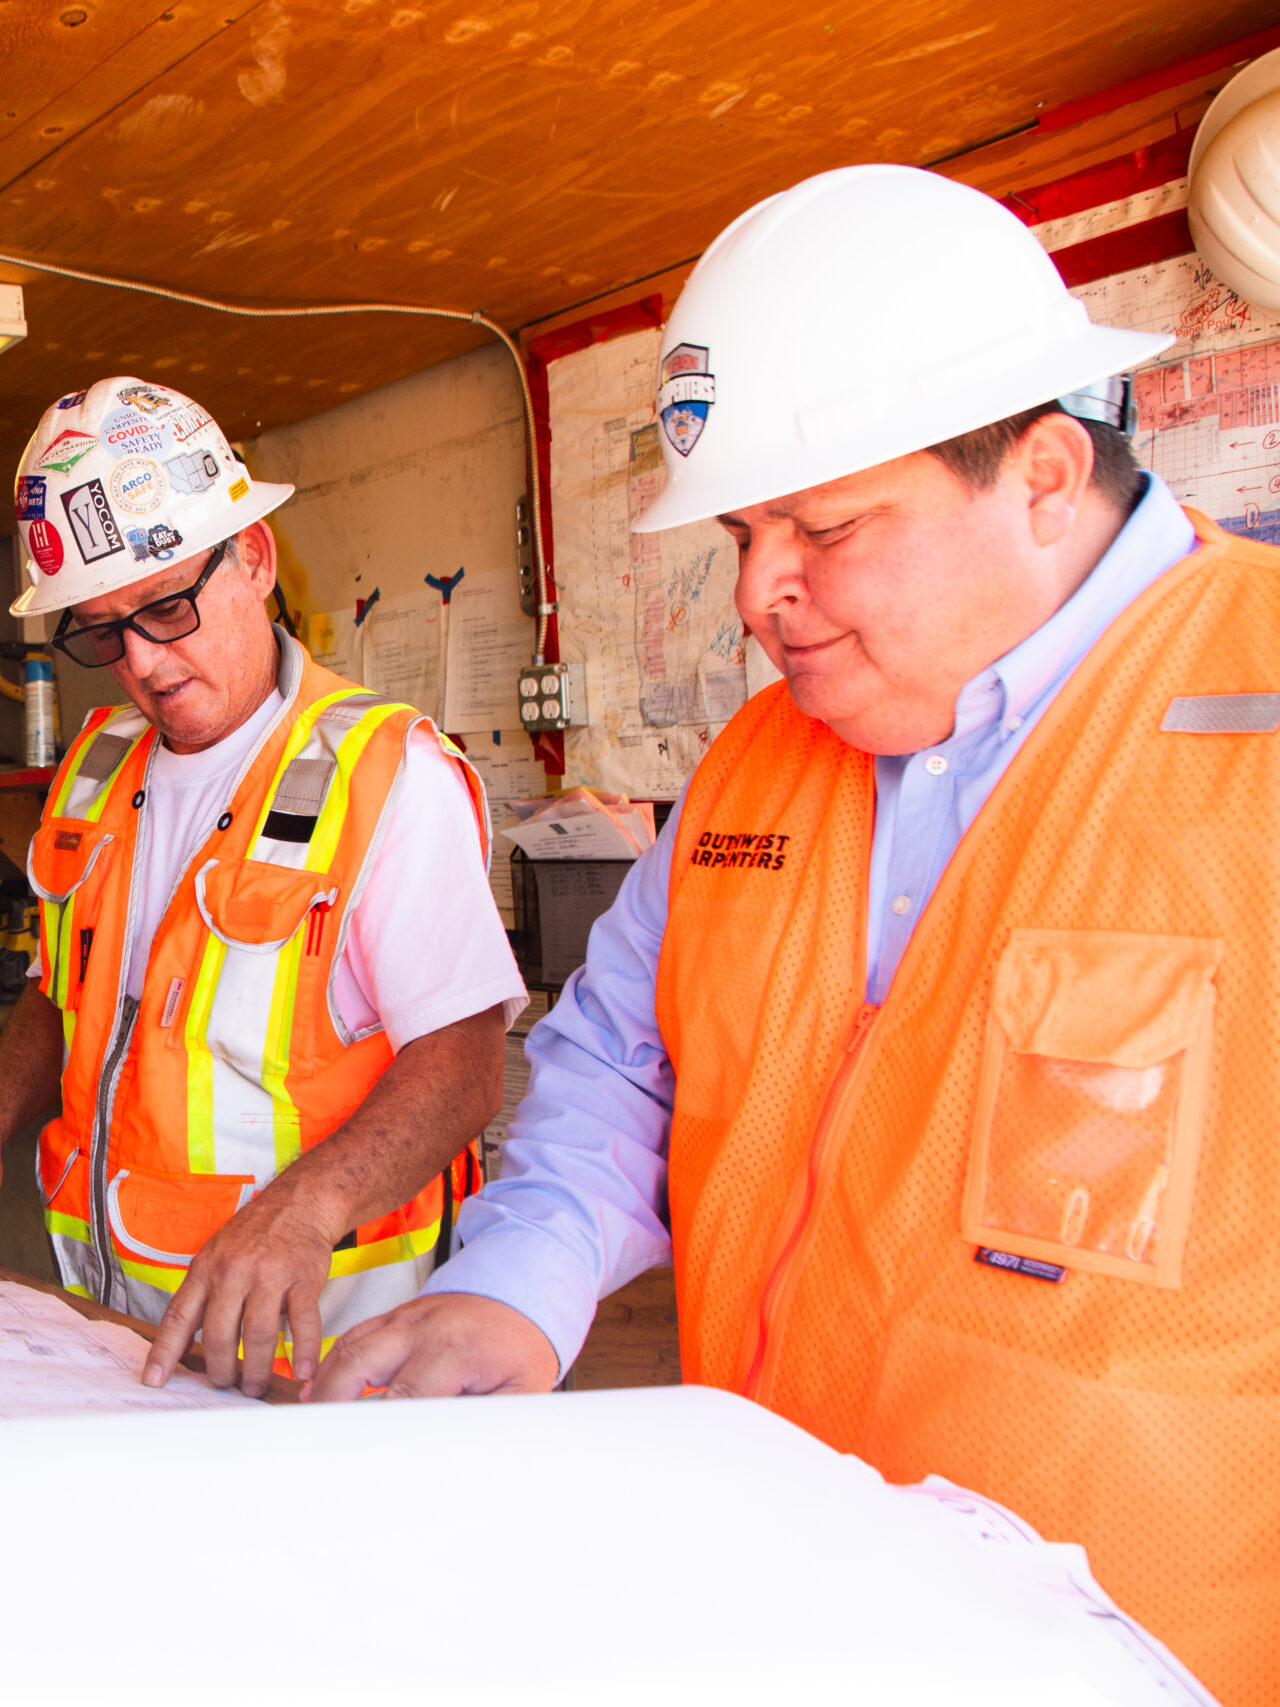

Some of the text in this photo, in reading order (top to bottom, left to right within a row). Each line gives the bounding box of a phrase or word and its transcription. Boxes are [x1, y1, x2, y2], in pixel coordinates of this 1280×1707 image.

[121, 433, 161, 450] SAFETY
[122, 472, 152, 494] ARCO
[126, 482, 154, 500] SAFE
[72, 502, 99, 549] Y
[90, 482, 121, 550] YOCOM
[152, 530, 167, 541] EAT
[691, 849, 786, 870] ARPENTERS
